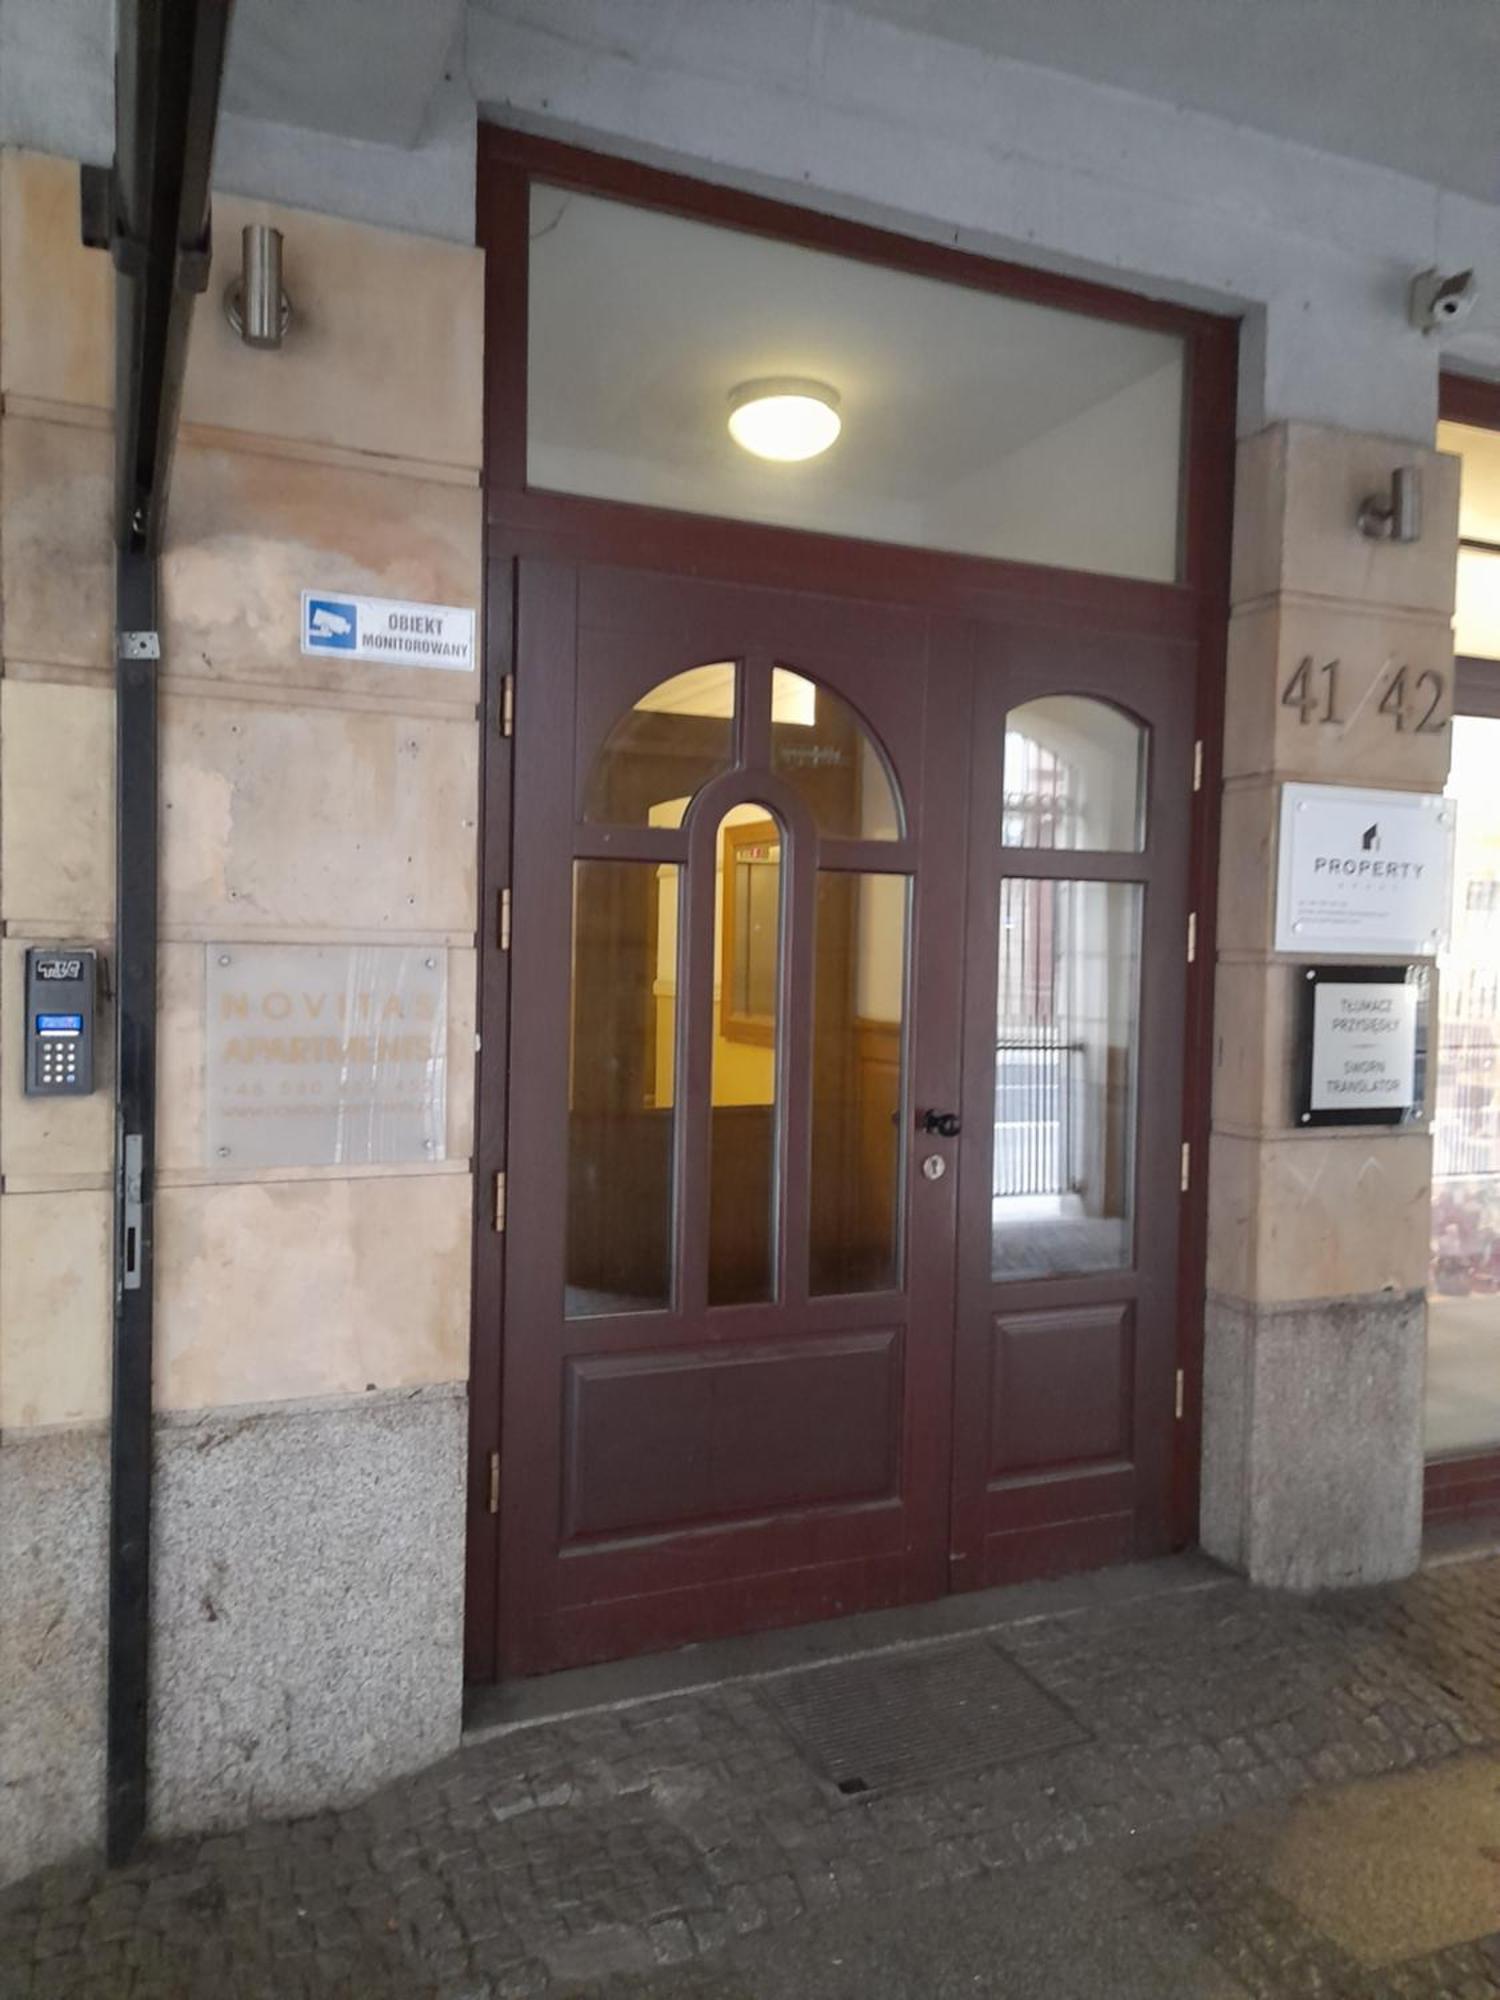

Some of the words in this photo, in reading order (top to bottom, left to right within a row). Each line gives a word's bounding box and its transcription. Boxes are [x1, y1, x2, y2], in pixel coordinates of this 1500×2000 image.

[388, 613, 443, 636] OBIEKT
[362, 633, 469, 658] MONITOROWANY
[1281, 654, 1344, 725] 41
[1377, 664, 1447, 734] 42
[1314, 857, 1425, 880] PROPERTY
[219, 990, 436, 1022] NOVITAS
[1327, 1079, 1401, 1095] TRANSLATOR
